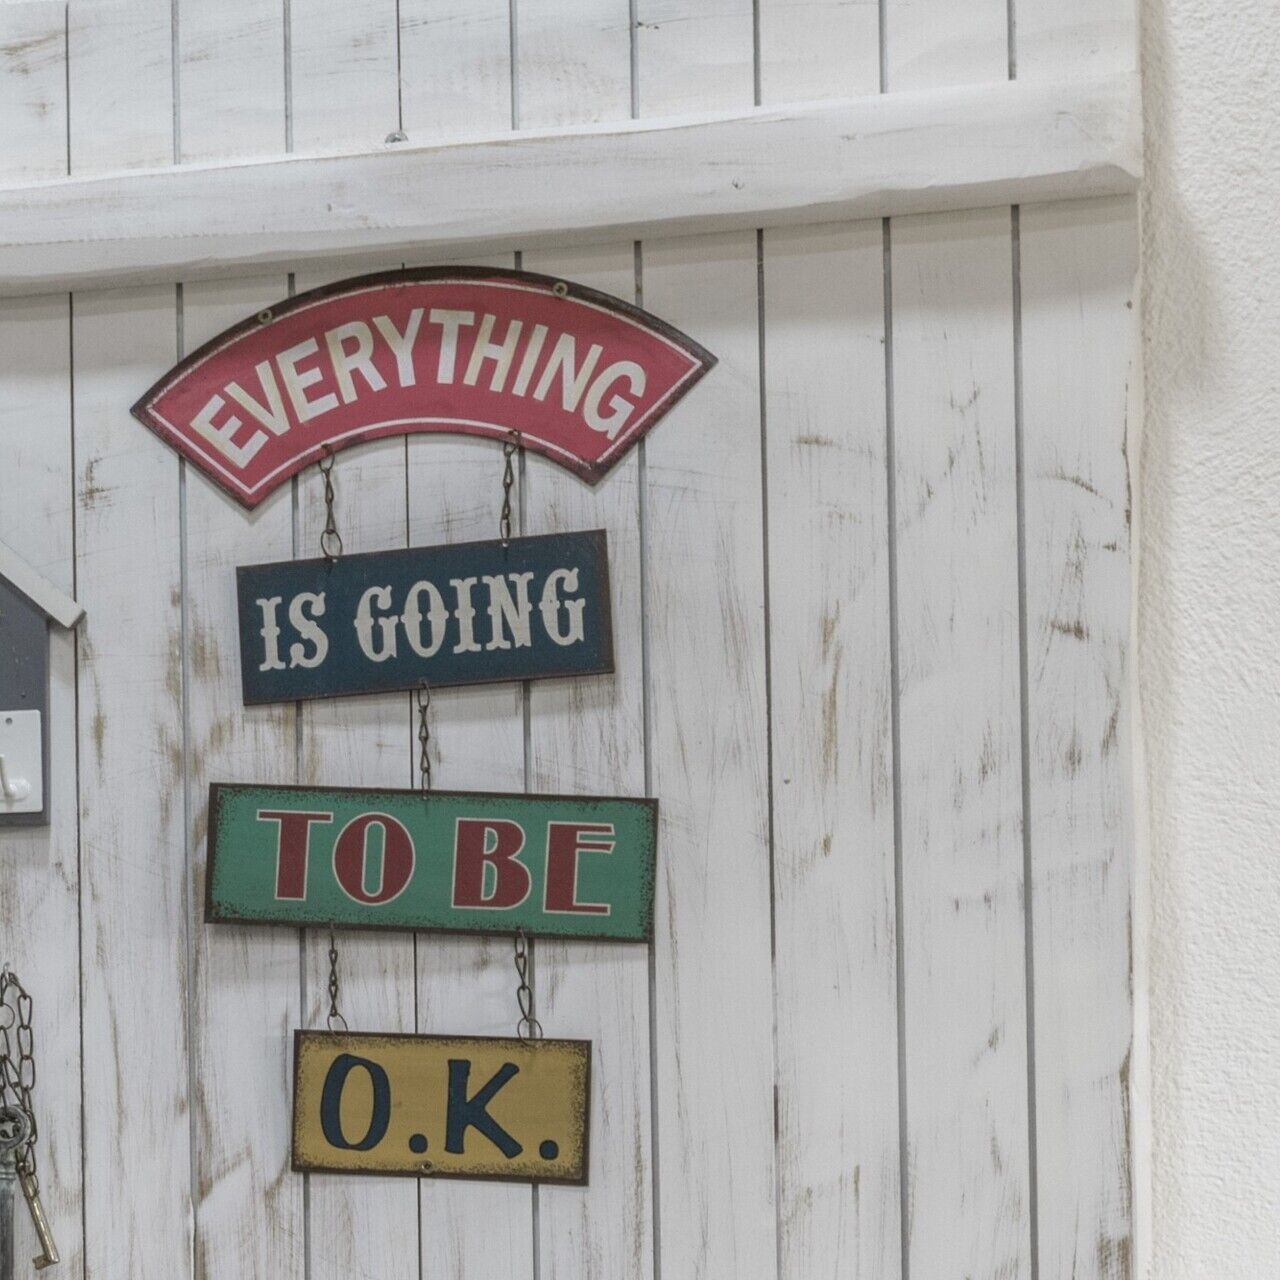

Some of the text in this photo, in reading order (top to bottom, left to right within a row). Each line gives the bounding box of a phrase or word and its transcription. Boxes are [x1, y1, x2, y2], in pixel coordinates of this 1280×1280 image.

[190, 307, 647, 469] EVERYTHING
[255, 567, 586, 672] IS GOING
[256, 808, 617, 916] TO BE
[320, 1053, 559, 1160] O.K.
